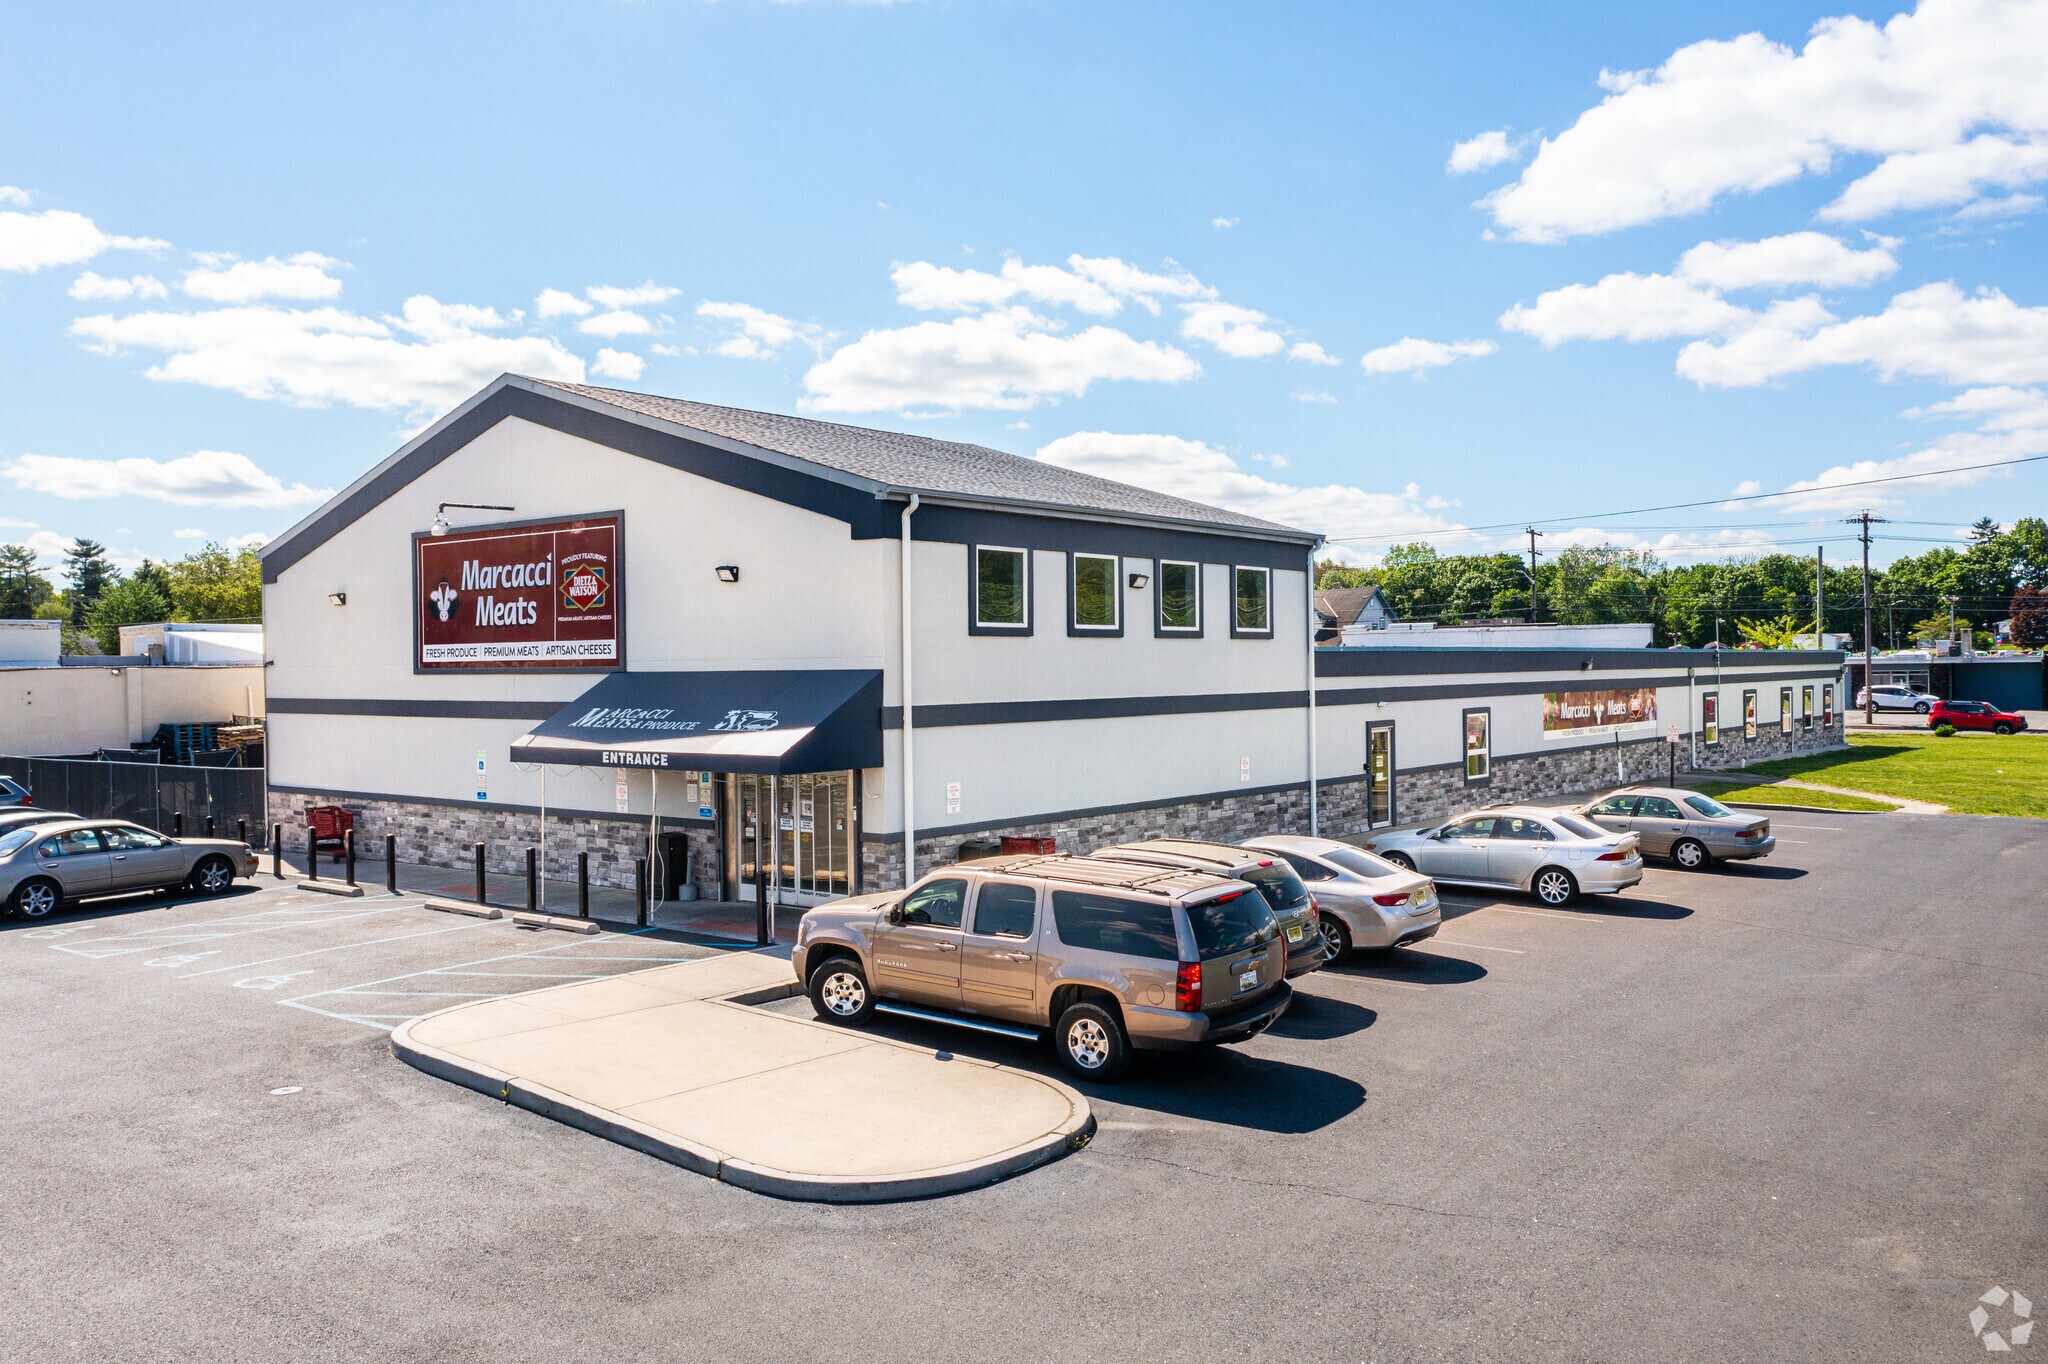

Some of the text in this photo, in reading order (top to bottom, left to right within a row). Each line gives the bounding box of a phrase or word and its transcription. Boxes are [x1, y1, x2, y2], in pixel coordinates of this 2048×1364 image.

[561, 552, 608, 566] PROUDLY FEATURING
[461, 552, 552, 591] Marcacci
[573, 576, 598, 586] DIETZ &
[569, 585, 598, 597] WATSON
[475, 596, 537, 627] Meats
[426, 647, 478, 658] FRESH PRODUCE
[484, 645, 539, 657] PREMIUM MEATS
[545, 643, 612, 656] ARTISAN CHEESES
[1560, 701, 1591, 719] Marcacci
[1607, 700, 1627, 716] Meats
[568, 707, 675, 728] MARCACCI
[631, 720, 641, 730] &
[640, 721, 701, 731] PRODUCE
[602, 751, 669, 766] ENTRANCE
